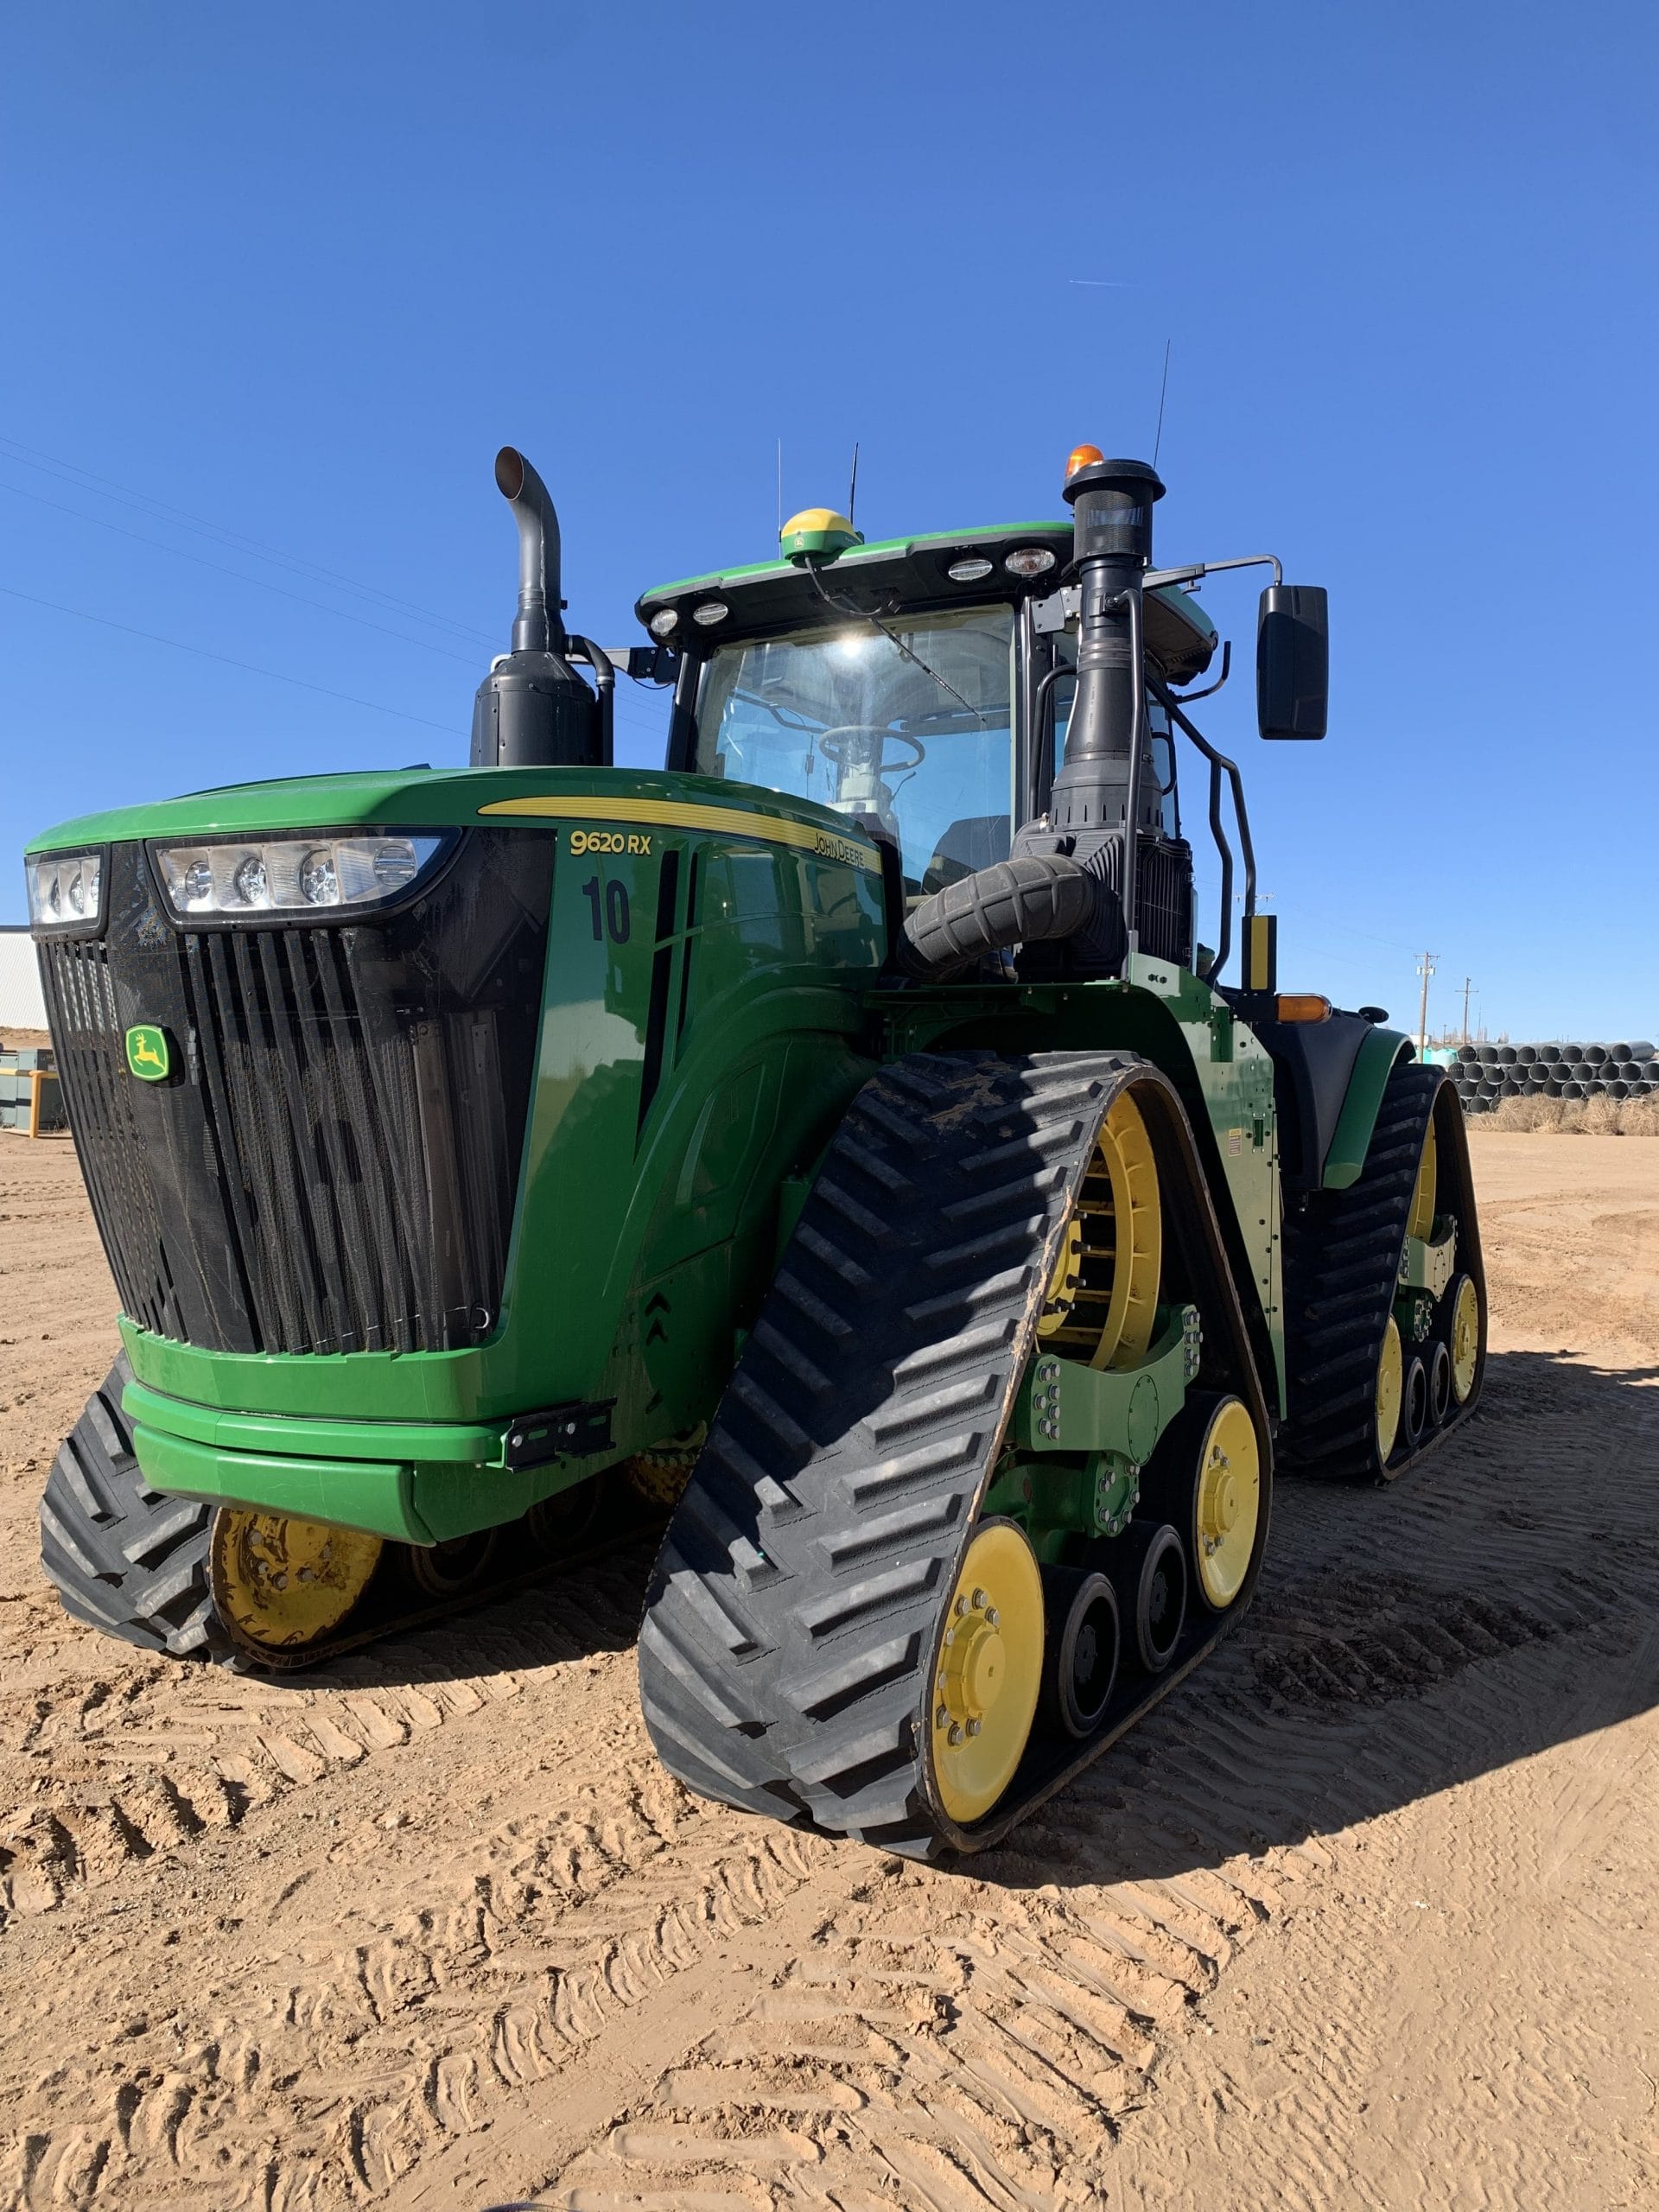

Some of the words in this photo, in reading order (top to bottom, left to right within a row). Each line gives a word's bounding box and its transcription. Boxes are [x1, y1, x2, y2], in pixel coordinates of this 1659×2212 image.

[570, 830, 625, 855] 9620
[627, 835, 652, 855] RX
[814, 832, 838, 857] JOHN
[838, 839, 865, 867] DEERE
[582, 876, 630, 944] 10
